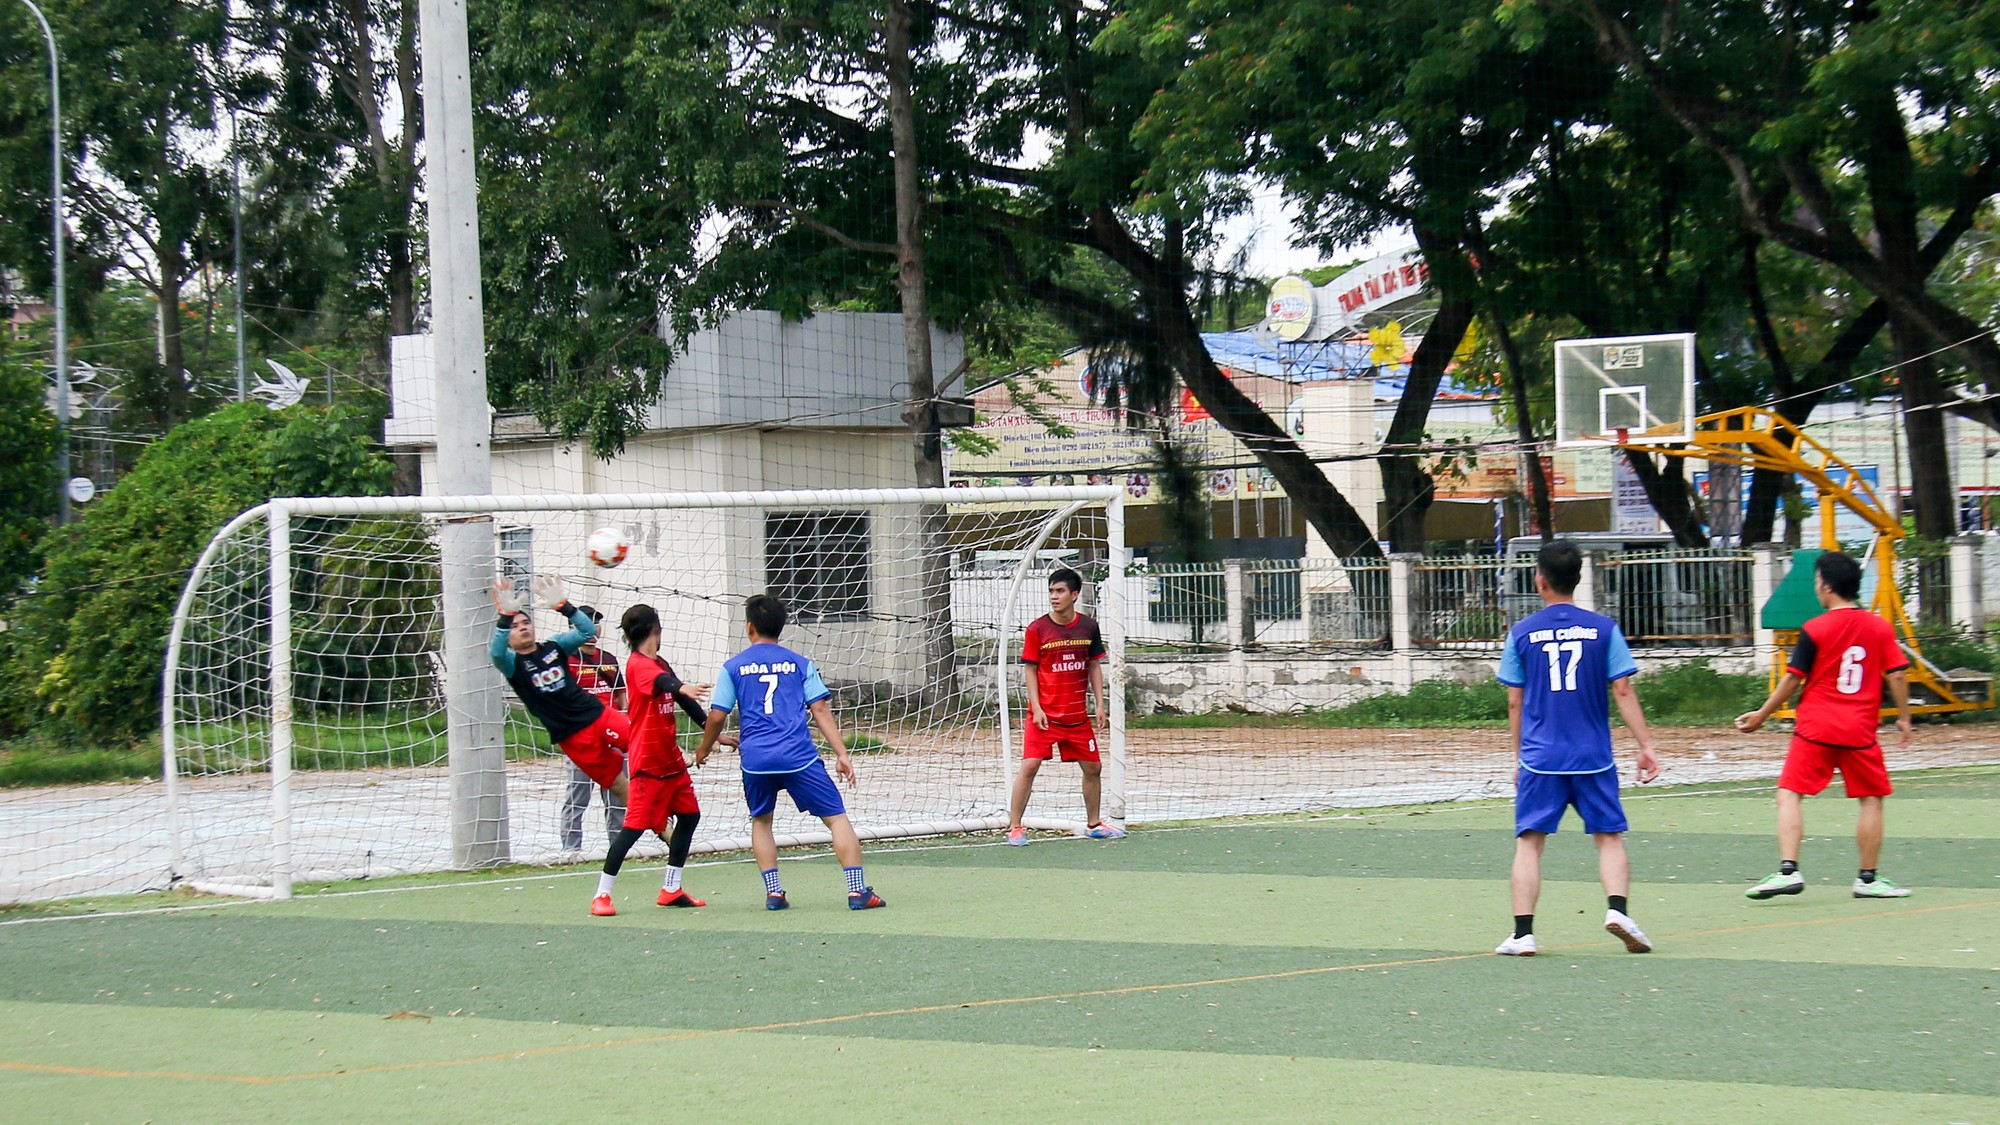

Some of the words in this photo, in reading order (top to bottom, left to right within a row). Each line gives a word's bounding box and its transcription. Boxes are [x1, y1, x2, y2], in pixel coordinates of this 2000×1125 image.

[1528, 629, 1554, 643] KIM
[740, 662, 769, 676] HÒA
[772, 661, 796, 675] HỘI
[1542, 641, 1583, 691] 17
[1836, 645, 1867, 694] 6
[759, 674, 778, 714] 7
